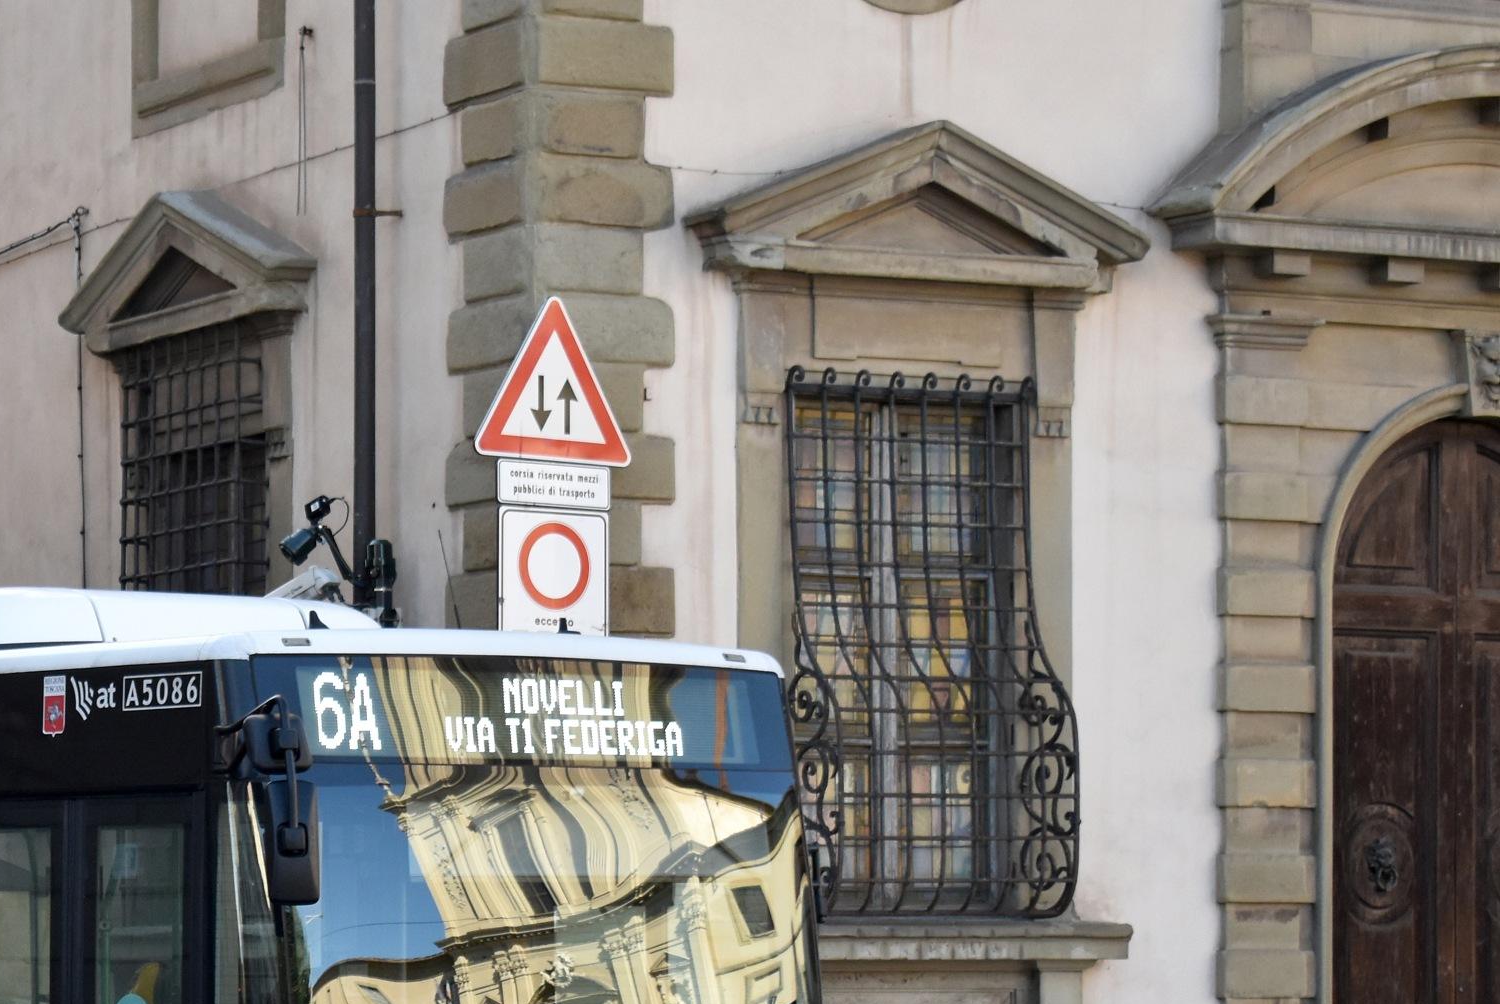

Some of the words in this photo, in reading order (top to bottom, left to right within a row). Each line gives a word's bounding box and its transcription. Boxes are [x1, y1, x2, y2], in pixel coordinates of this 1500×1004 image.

[510, 469, 534, 479] corsia
[538, 470, 573, 482] riservata
[577, 474, 599, 484] mezzi
[513, 484, 545, 496] pubblici
[548, 486, 556, 496] di
[559, 487, 595, 500] trasporto
[534, 618, 574, 627] ecceo
[125, 676, 198, 707] A5086
[502, 677, 625, 716] NOVELLI
[313, 672, 382, 750] 6A
[445, 716, 496, 753] VIA
[505, 717, 536, 754] T1
[543, 719, 684, 757] FEDERIGA
